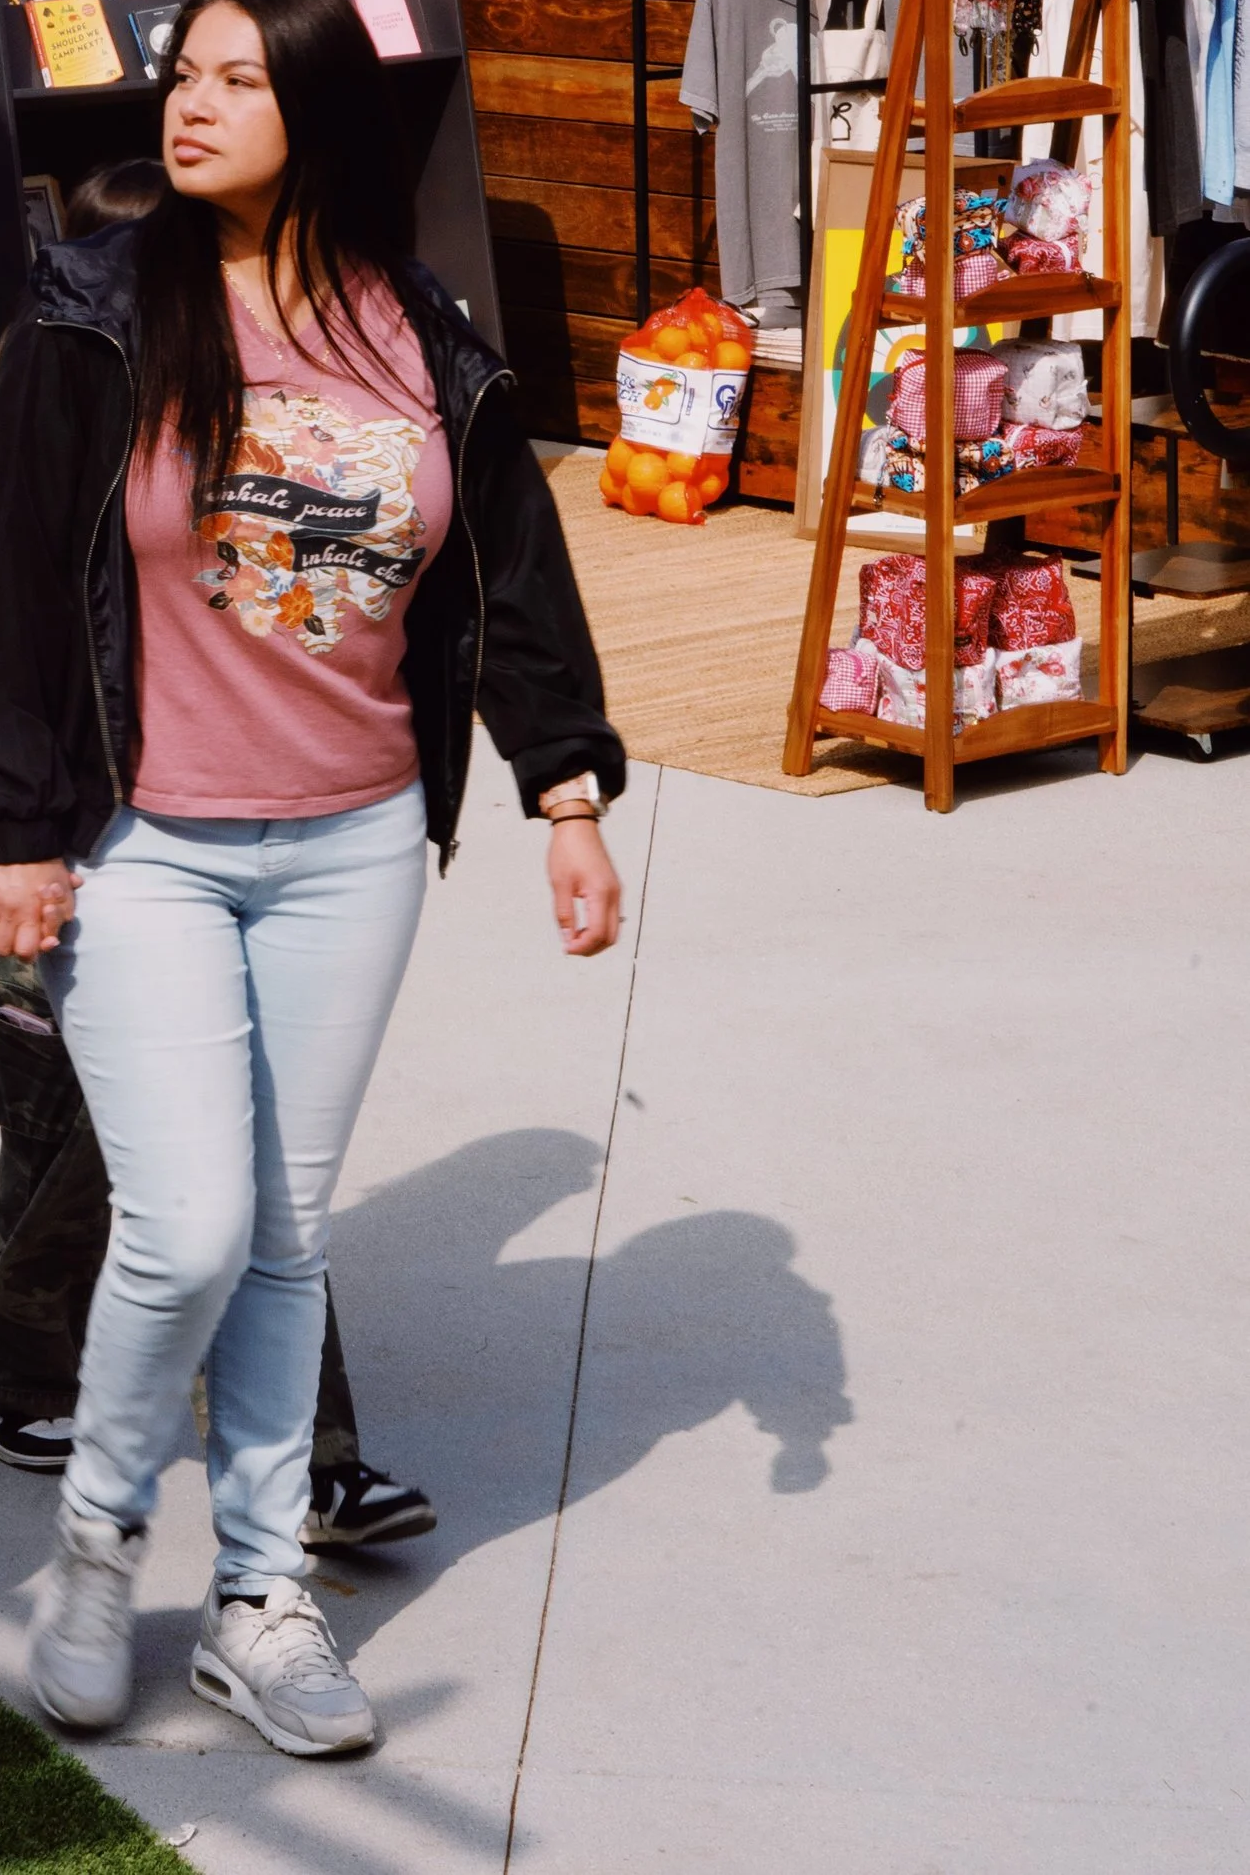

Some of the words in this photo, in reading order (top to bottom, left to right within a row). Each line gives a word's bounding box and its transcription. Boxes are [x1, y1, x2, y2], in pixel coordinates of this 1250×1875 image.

[59, 23, 87, 36] WHERE
[51, 34, 86, 50] SHOULD
[87, 30, 100, 39] WE
[52, 46, 76, 61] CAMP
[77, 37, 105, 53] NEXT?
[294, 501, 368, 522] peace
